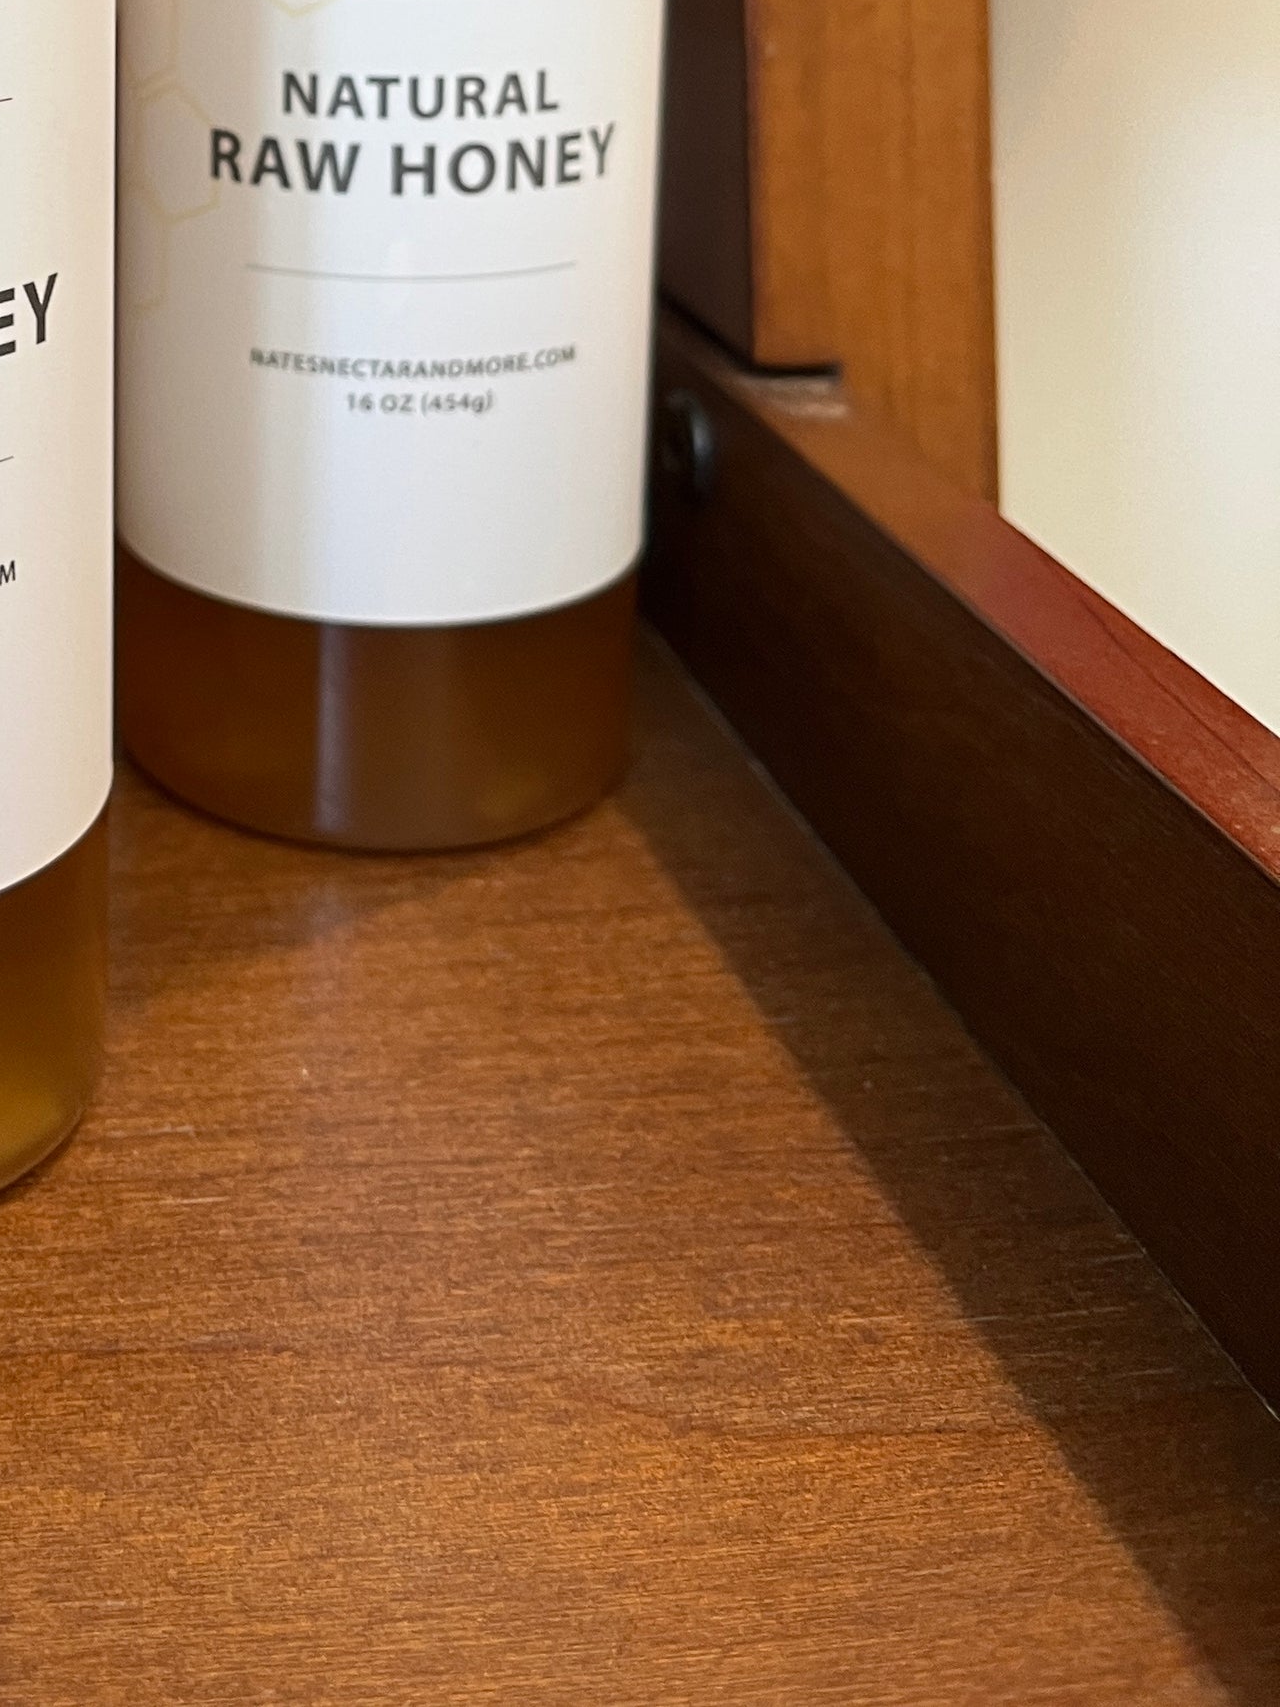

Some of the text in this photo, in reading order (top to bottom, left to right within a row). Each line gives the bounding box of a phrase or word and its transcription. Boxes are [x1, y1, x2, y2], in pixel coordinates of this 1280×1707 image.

[283, 70, 559, 120] NATURAL
[211, 123, 614, 196] RAW HONEY
[347, 392, 373, 412] 16
[380, 393, 414, 414] OZ
